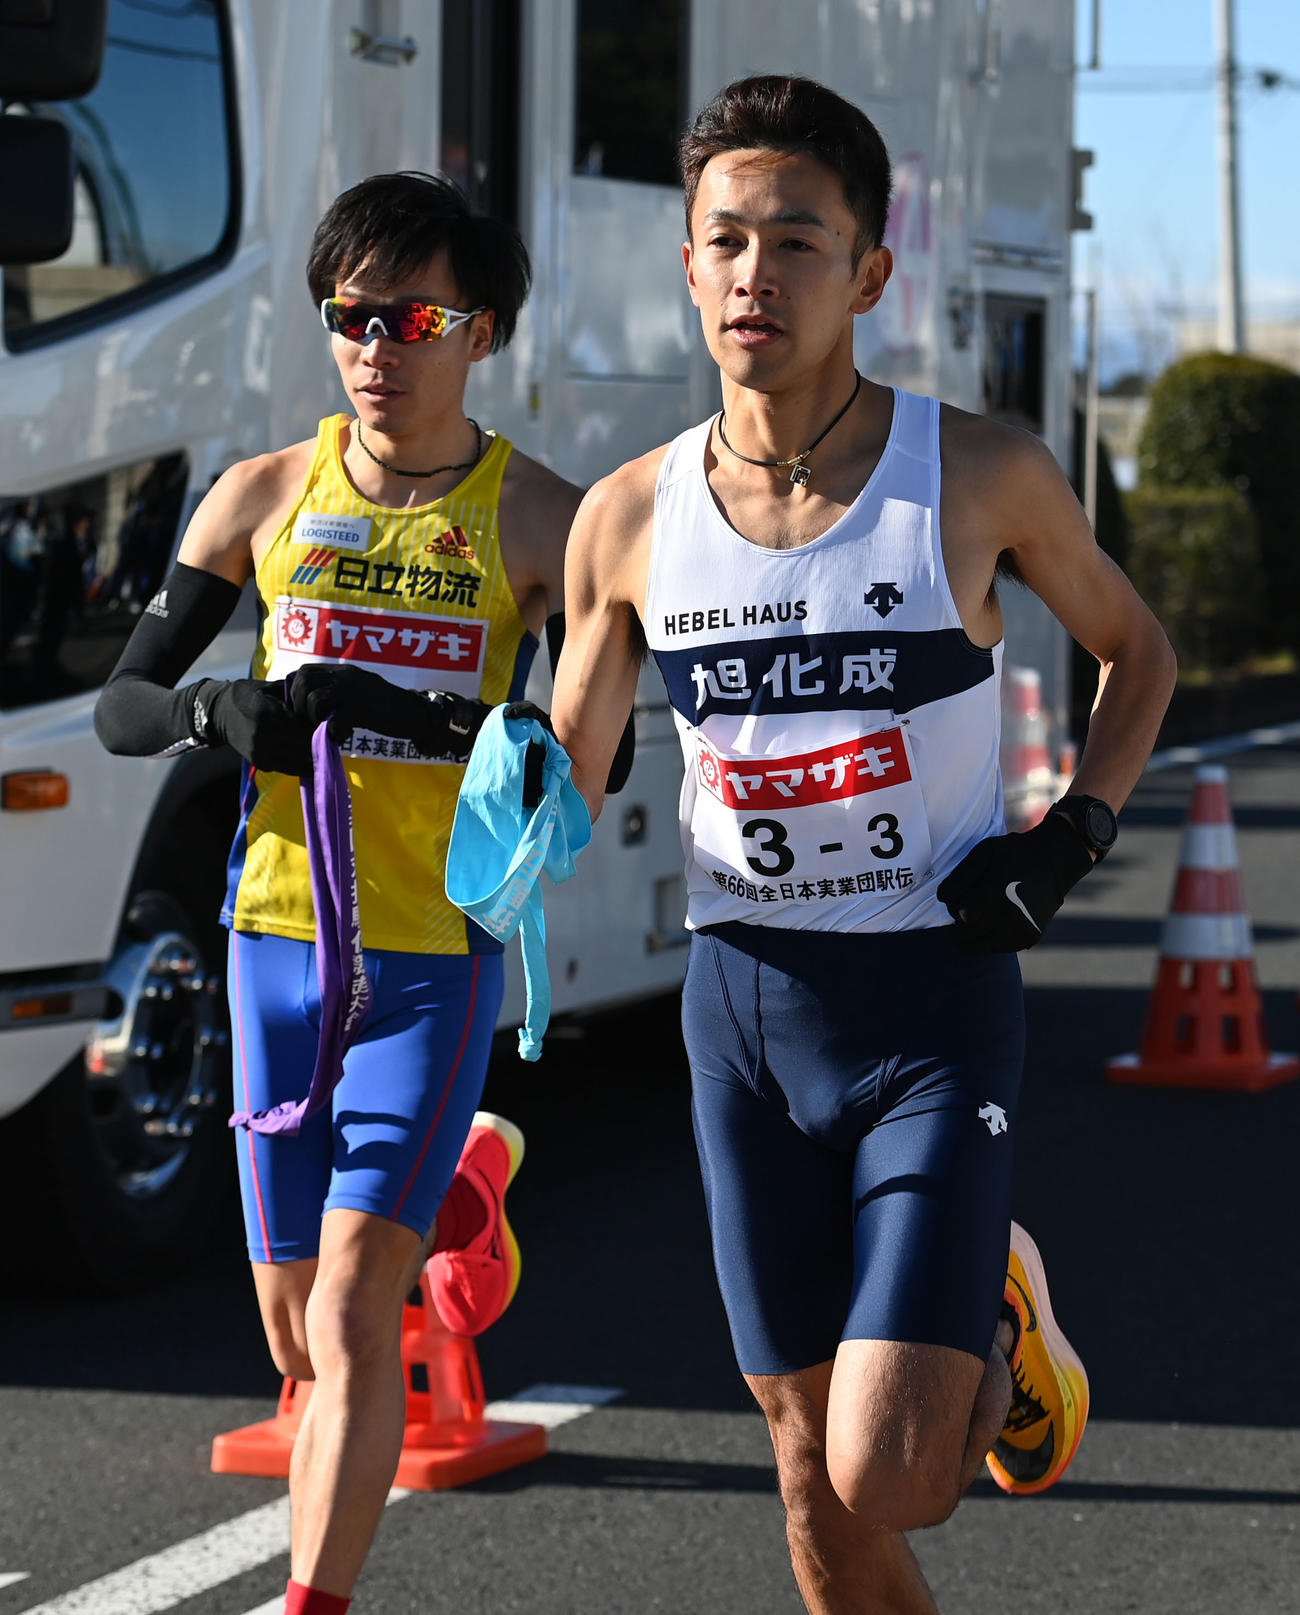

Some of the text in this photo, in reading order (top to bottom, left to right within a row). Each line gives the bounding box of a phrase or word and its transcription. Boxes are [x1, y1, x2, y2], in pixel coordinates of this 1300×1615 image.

[301, 527, 360, 543] LOGISTEED
[425, 543, 475, 560] adidas
[334, 556, 482, 608] 日立物流
[664, 599, 808, 636] HEBEL HAUS
[326, 618, 473, 662] ヤマザキ
[689, 647, 898, 711] 旭化成
[724, 746, 896, 801] ヤマザキ
[741, 818, 795, 877] 3
[867, 812, 905, 860] 3
[711, 866, 914, 903] 第66回全日本実業団駅伝
